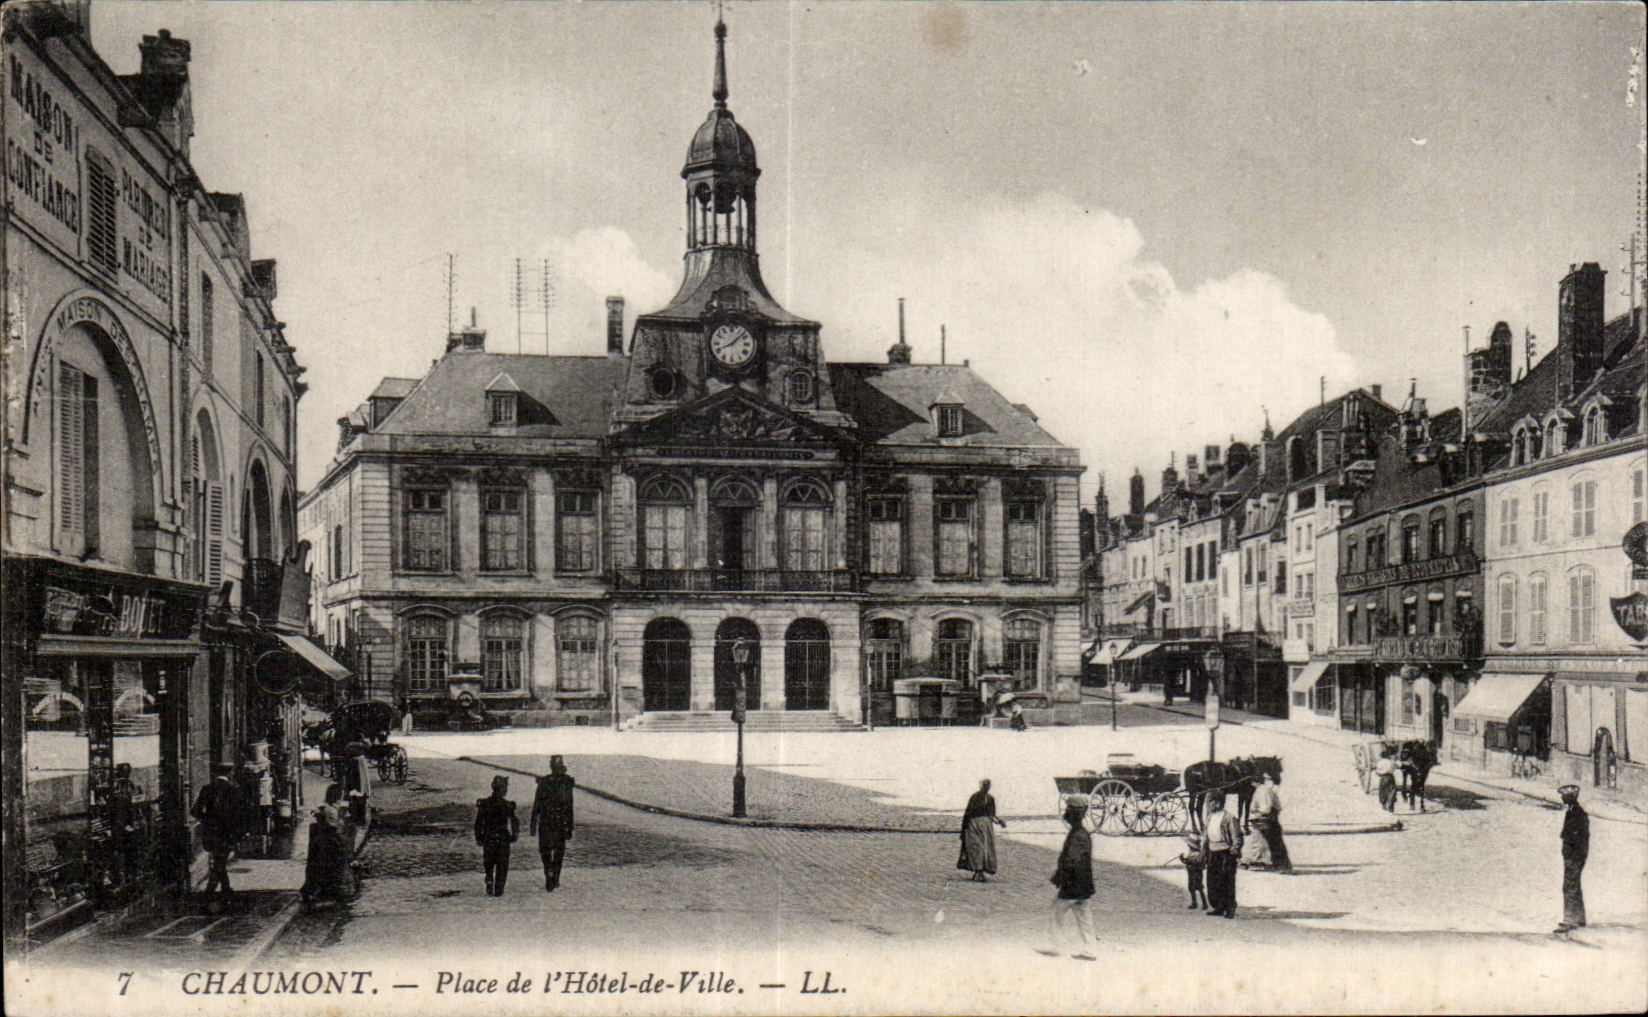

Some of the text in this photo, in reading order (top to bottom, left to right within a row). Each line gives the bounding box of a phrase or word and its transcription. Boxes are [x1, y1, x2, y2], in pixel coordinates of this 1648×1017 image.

[10, 53, 73, 155] MAISON
[34, 130, 53, 165] DE
[8, 136, 79, 235] CONFIANCE
[139, 225, 153, 252] DE
[56, 300, 102, 335] MAISON
